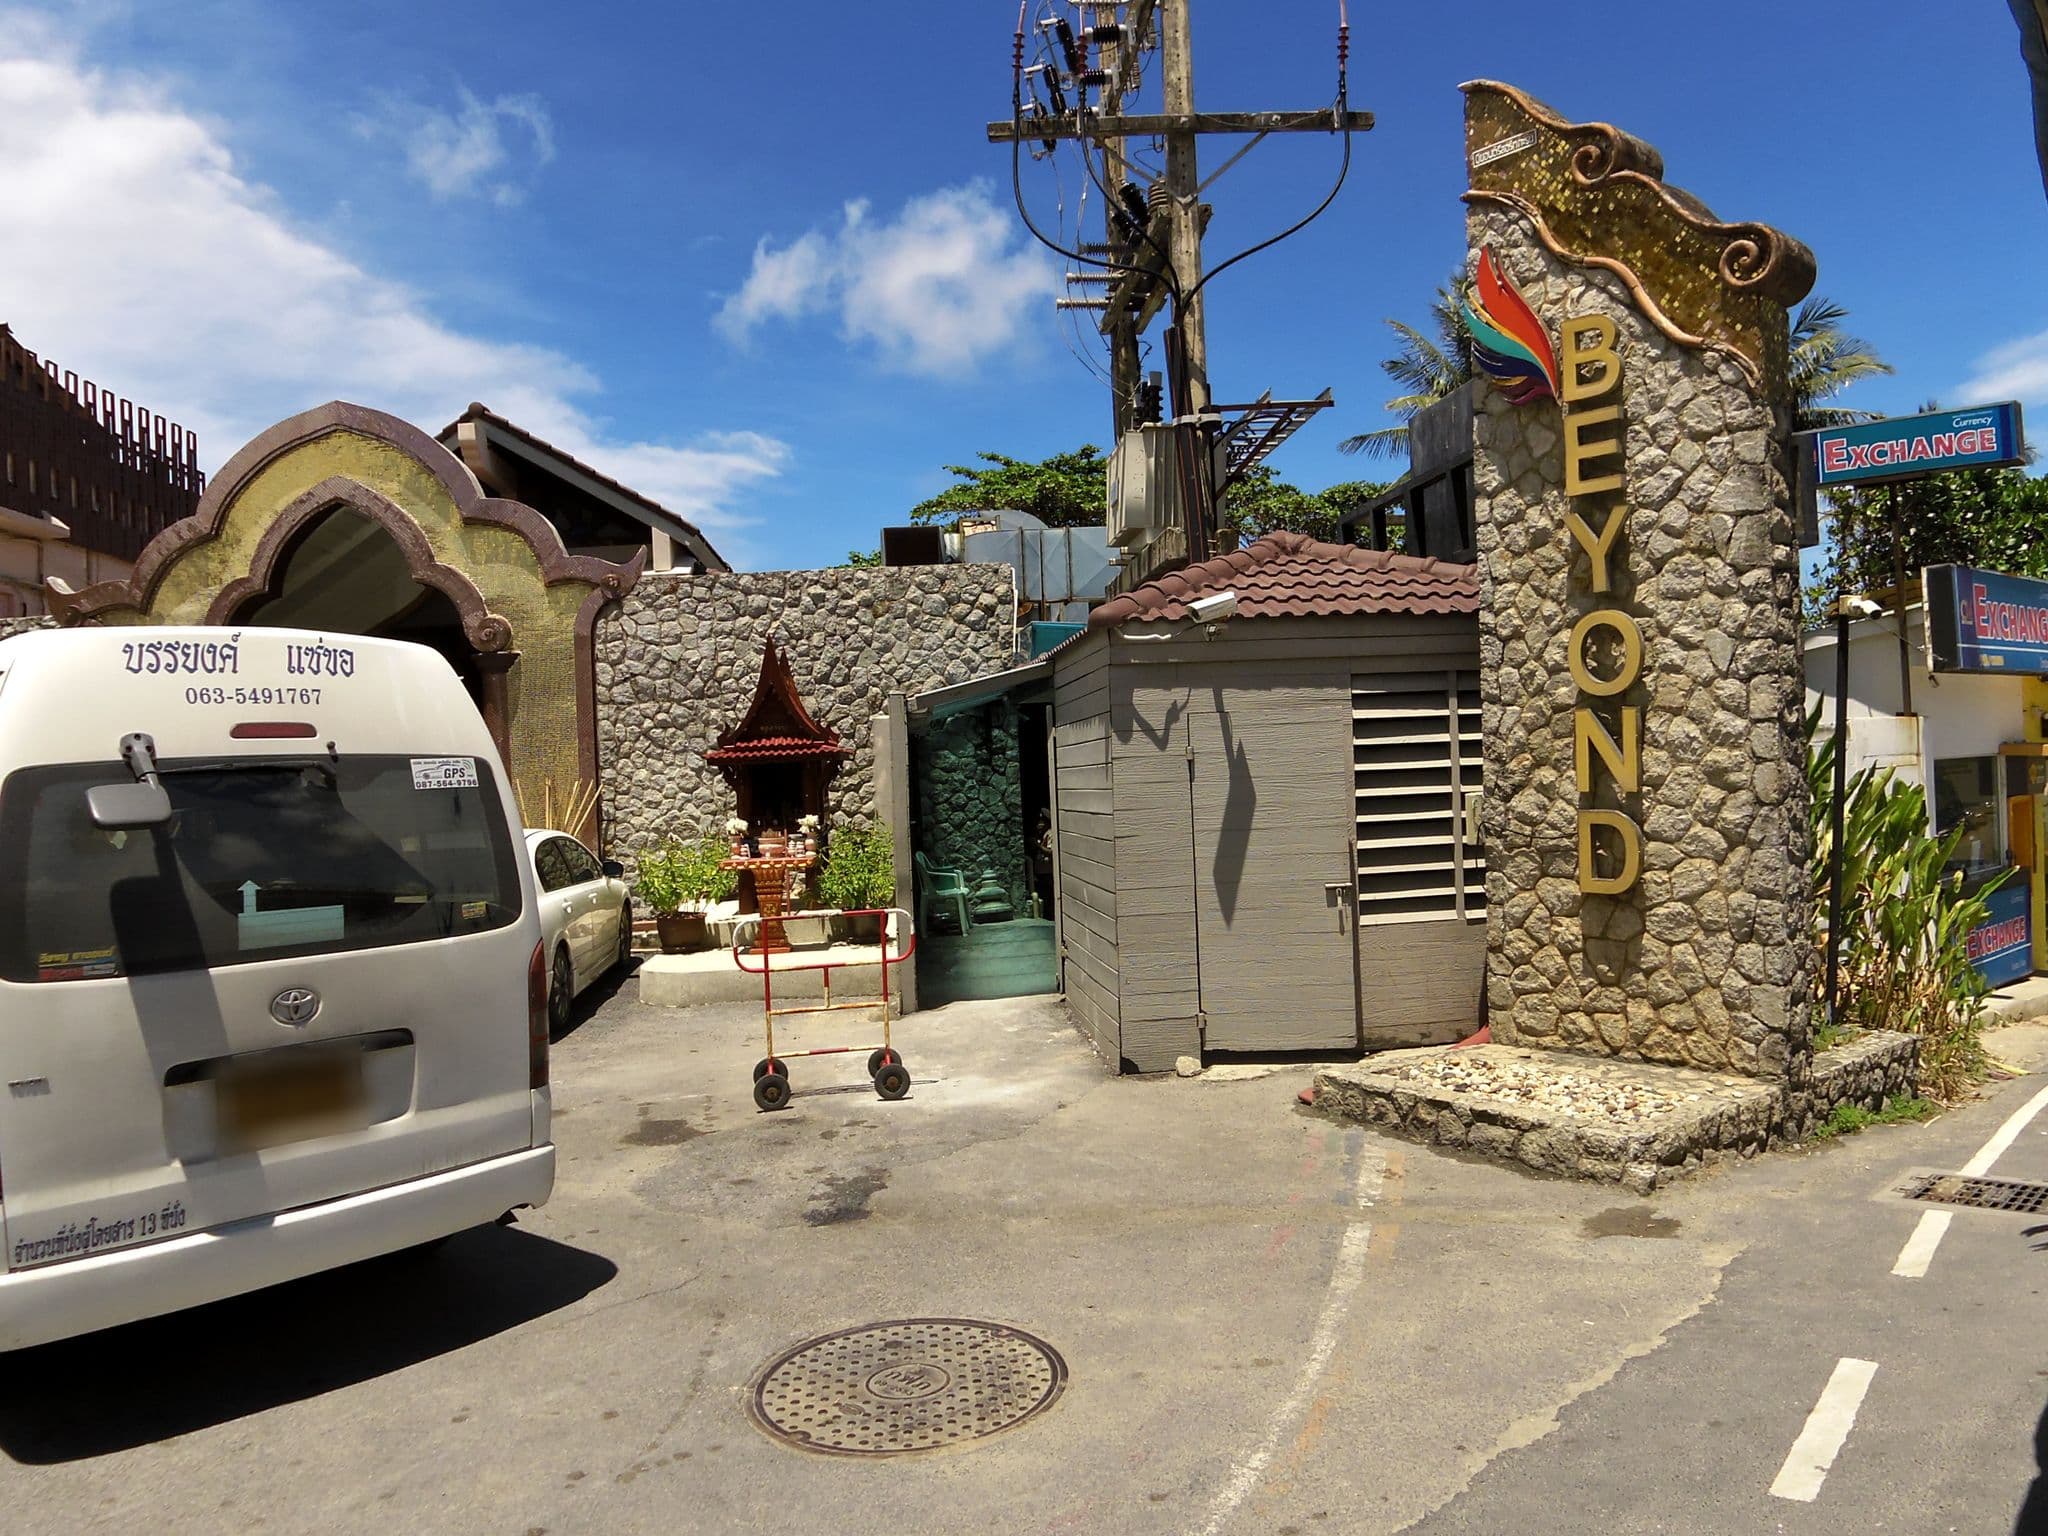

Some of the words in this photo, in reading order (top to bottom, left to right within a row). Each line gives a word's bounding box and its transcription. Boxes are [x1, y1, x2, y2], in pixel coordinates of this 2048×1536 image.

[1952, 416, 1993, 428] Currency
[1823, 428, 1996, 473] EXCHANGE
[1560, 314, 1645, 896] BEYOND
[122, 632, 241, 674] บรรยงค์
[185, 688, 321, 705] 063-5491767
[444, 767, 465, 779] GPS
[1967, 915, 2026, 961] EXCHANGE
[140, 1212, 156, 1236] 13
